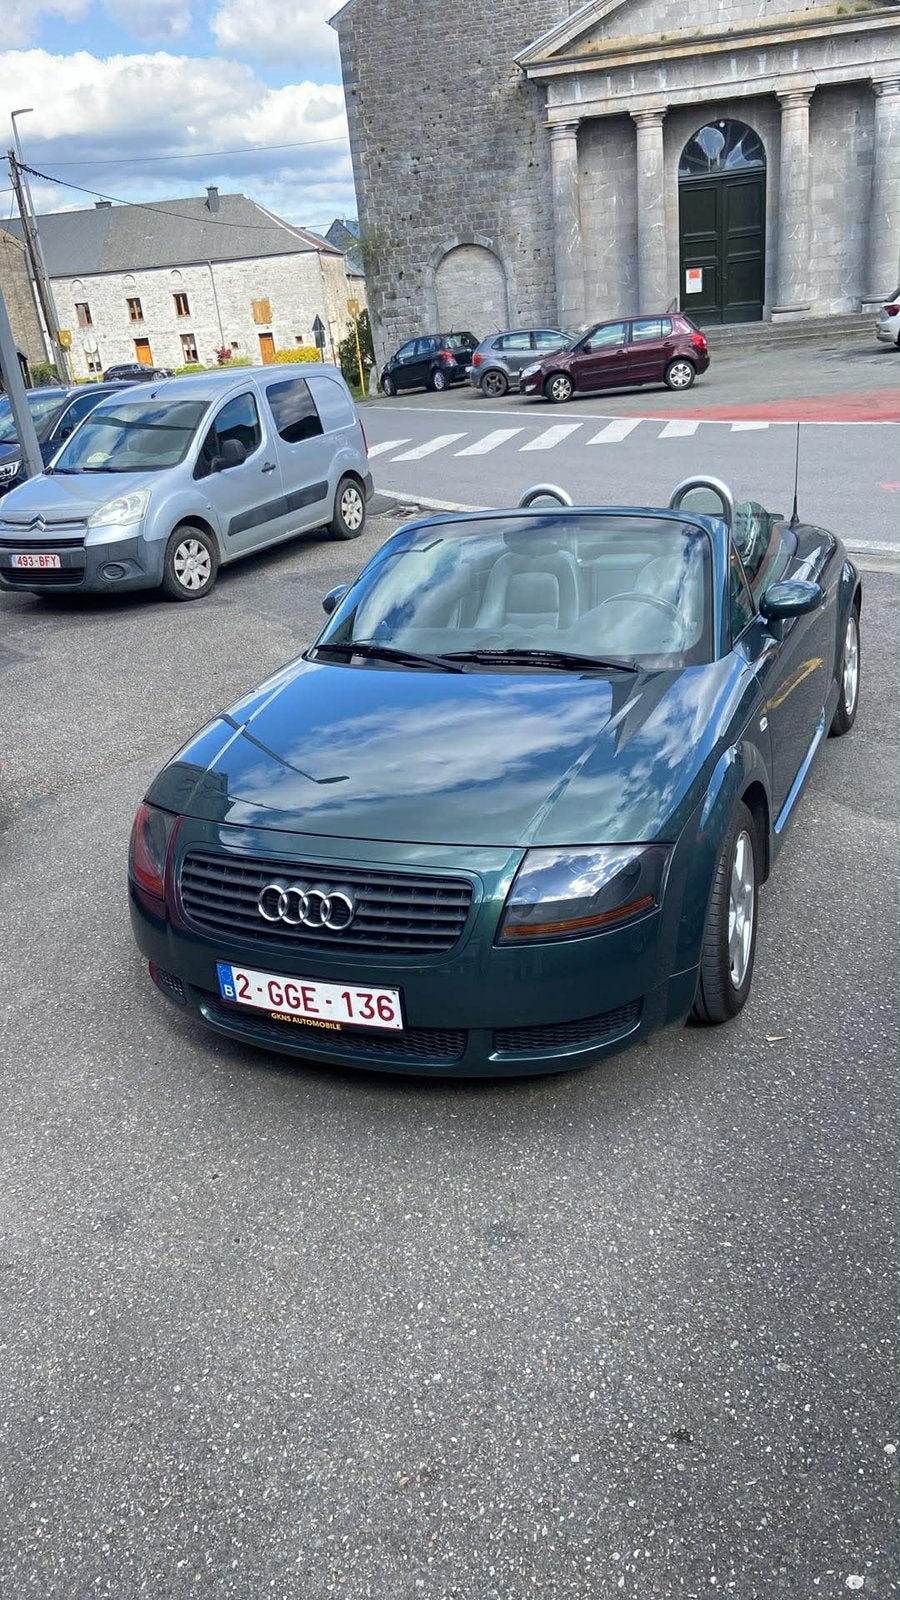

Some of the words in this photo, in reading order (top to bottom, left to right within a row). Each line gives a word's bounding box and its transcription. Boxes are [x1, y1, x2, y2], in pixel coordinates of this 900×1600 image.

[17, 555, 56, 567] 493-BFY
[224, 984, 234, 997] B
[292, 1016, 342, 1031] AUTOMOBILE
